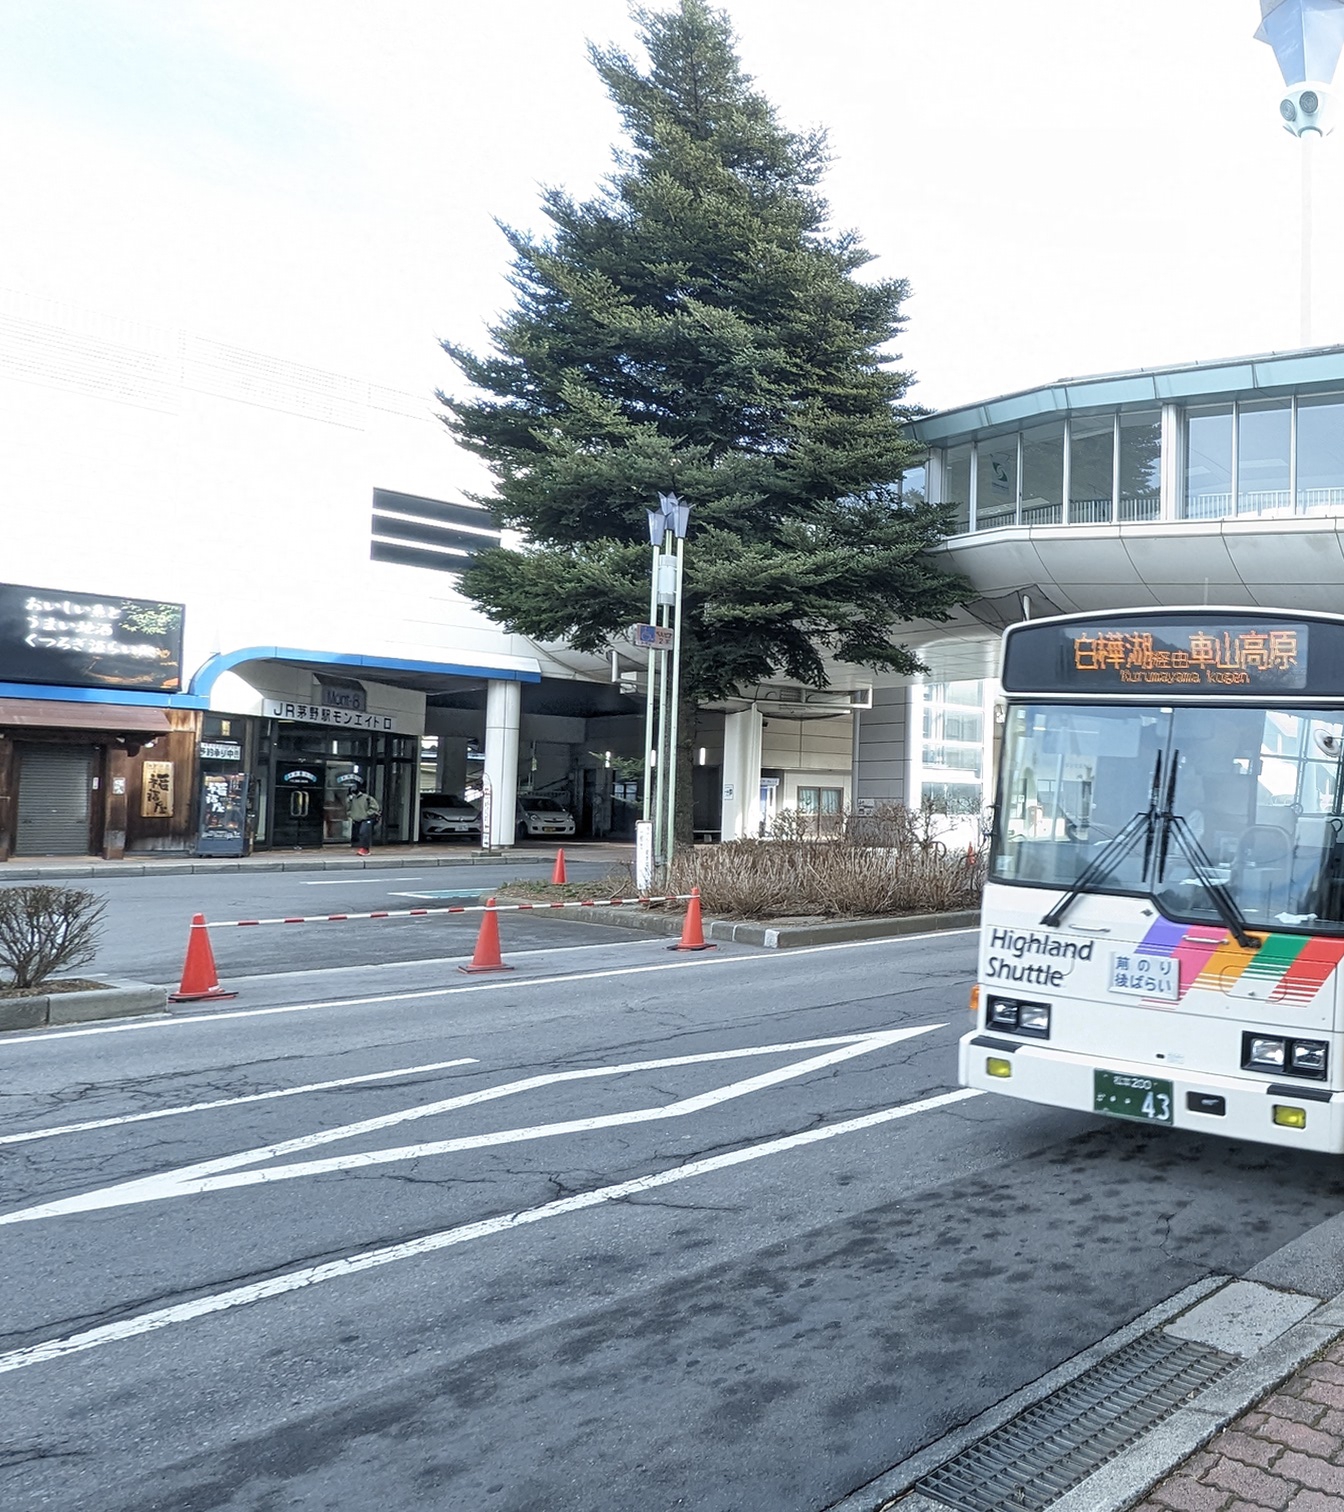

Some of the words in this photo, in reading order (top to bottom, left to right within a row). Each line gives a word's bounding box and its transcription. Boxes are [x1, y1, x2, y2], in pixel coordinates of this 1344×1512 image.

[989, 928, 1095, 961] Highland
[986, 957, 1065, 988] Shuttle
[1115, 956, 1172, 976] 前のり
[1115, 973, 1171, 993] 後ばらい
[1141, 1091, 1170, 1121] 43
